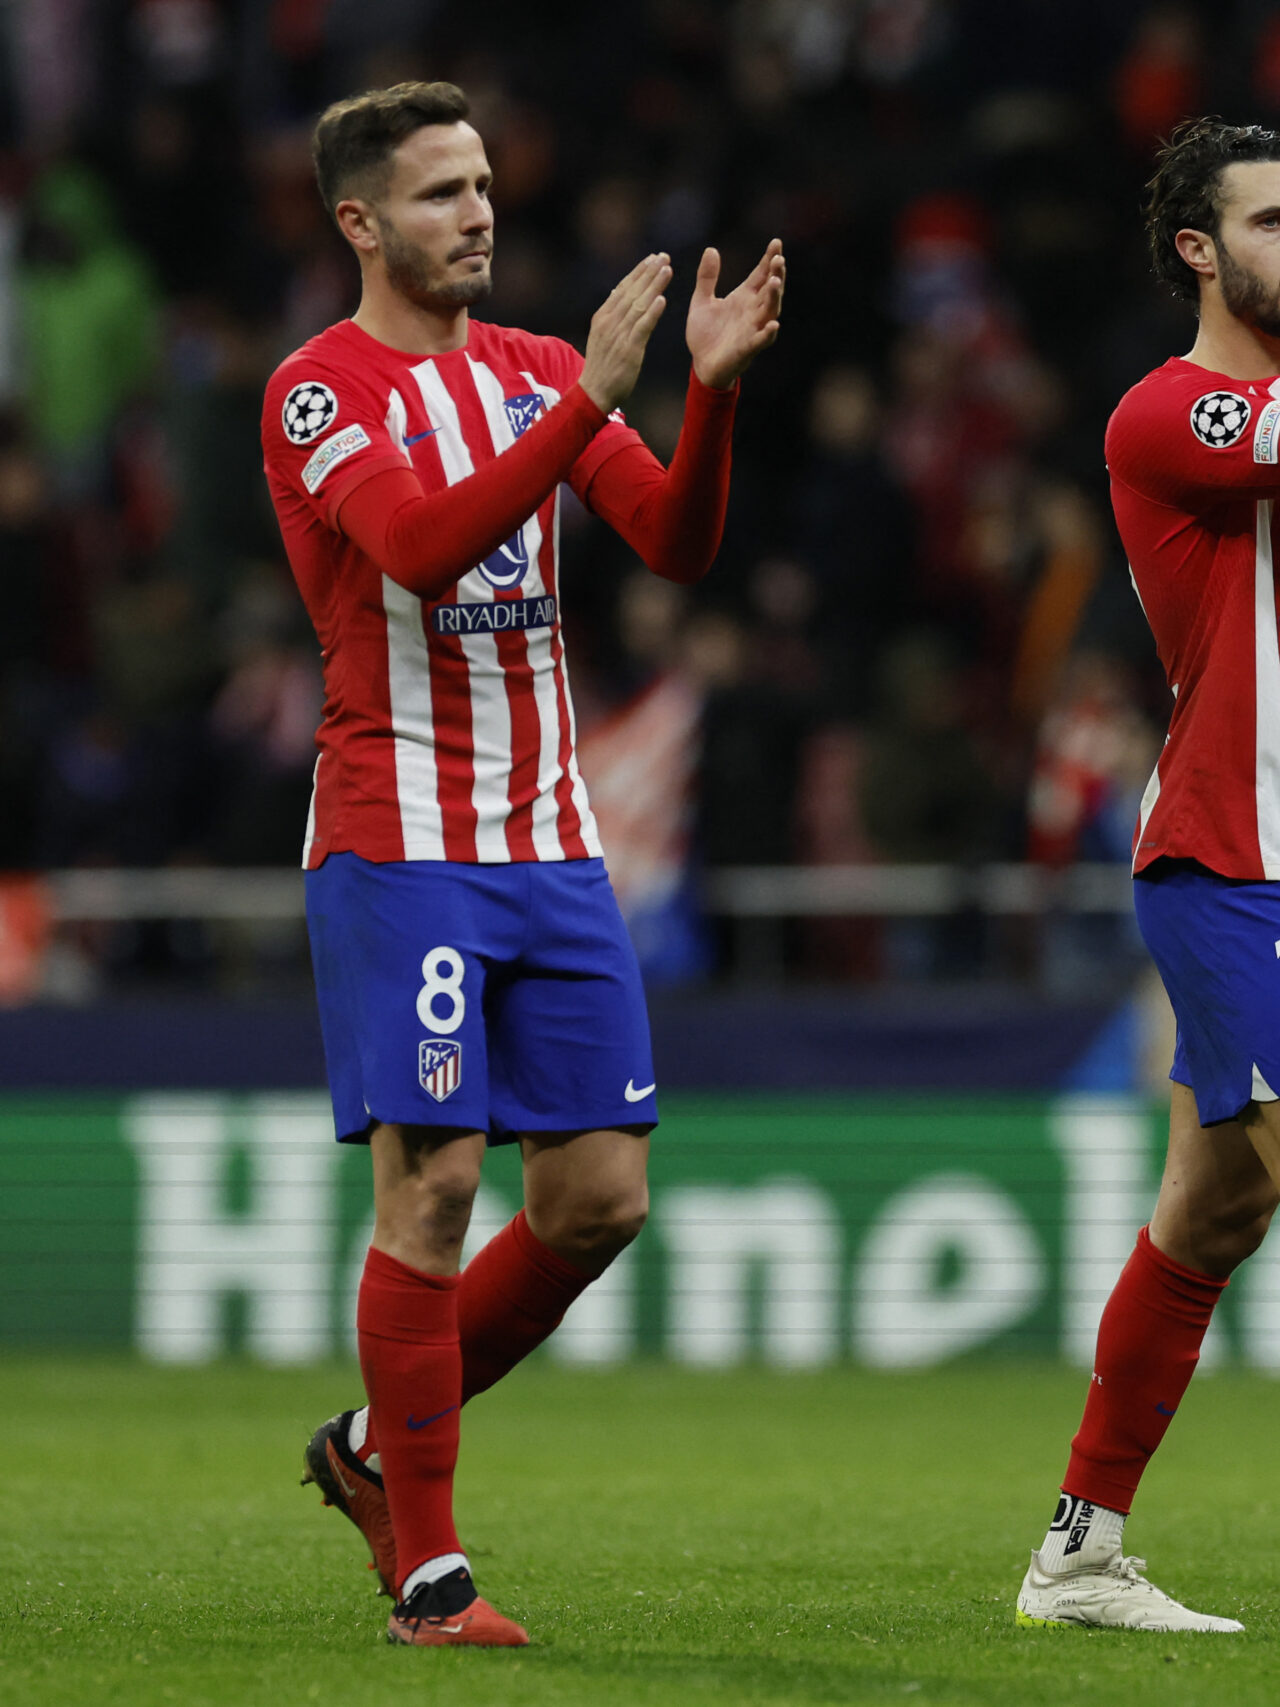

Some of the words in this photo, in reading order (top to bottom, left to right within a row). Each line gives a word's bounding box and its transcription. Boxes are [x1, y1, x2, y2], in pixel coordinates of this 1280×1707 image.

[438, 602, 528, 632] RIYADH
[533, 598, 556, 624] AIR
[416, 946, 465, 1035] 8
[1056, 1598, 1077, 1607] COPA
